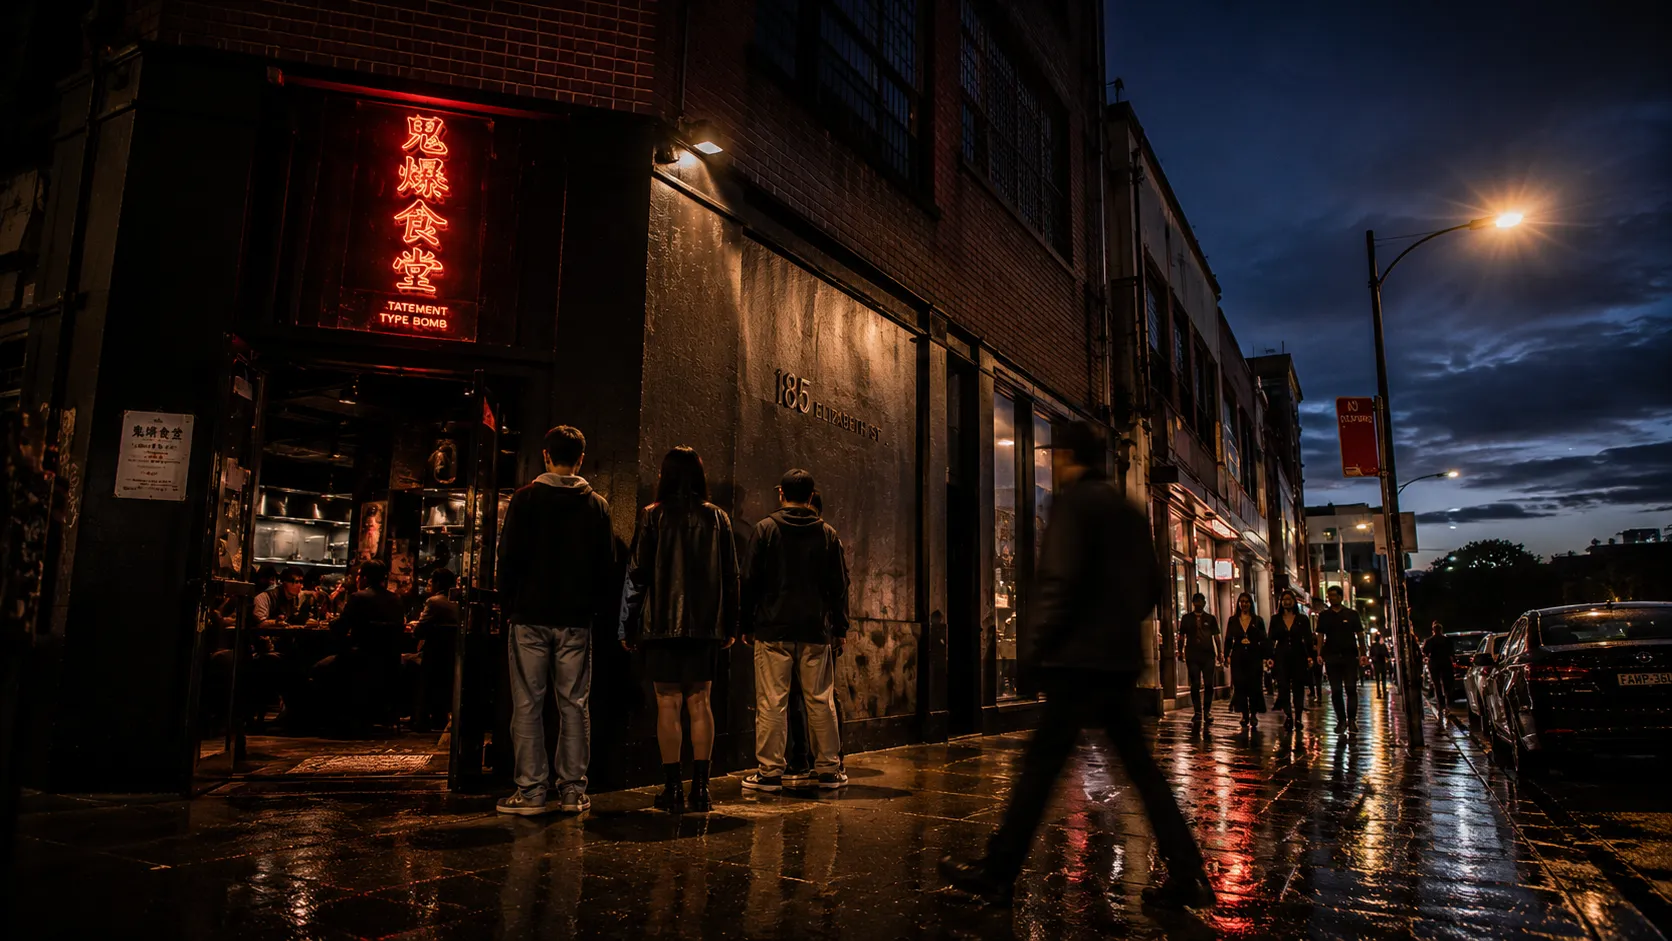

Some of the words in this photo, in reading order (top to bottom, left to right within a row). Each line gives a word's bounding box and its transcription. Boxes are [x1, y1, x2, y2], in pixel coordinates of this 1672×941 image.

[387, 300, 448, 316] TATEMENT
[379, 312, 409, 325] TYPE
[412, 315, 447, 329] BOMB
[774, 369, 811, 414] 185
[813, 401, 866, 437] ELIZABETH
[868, 424, 882, 443] ST
